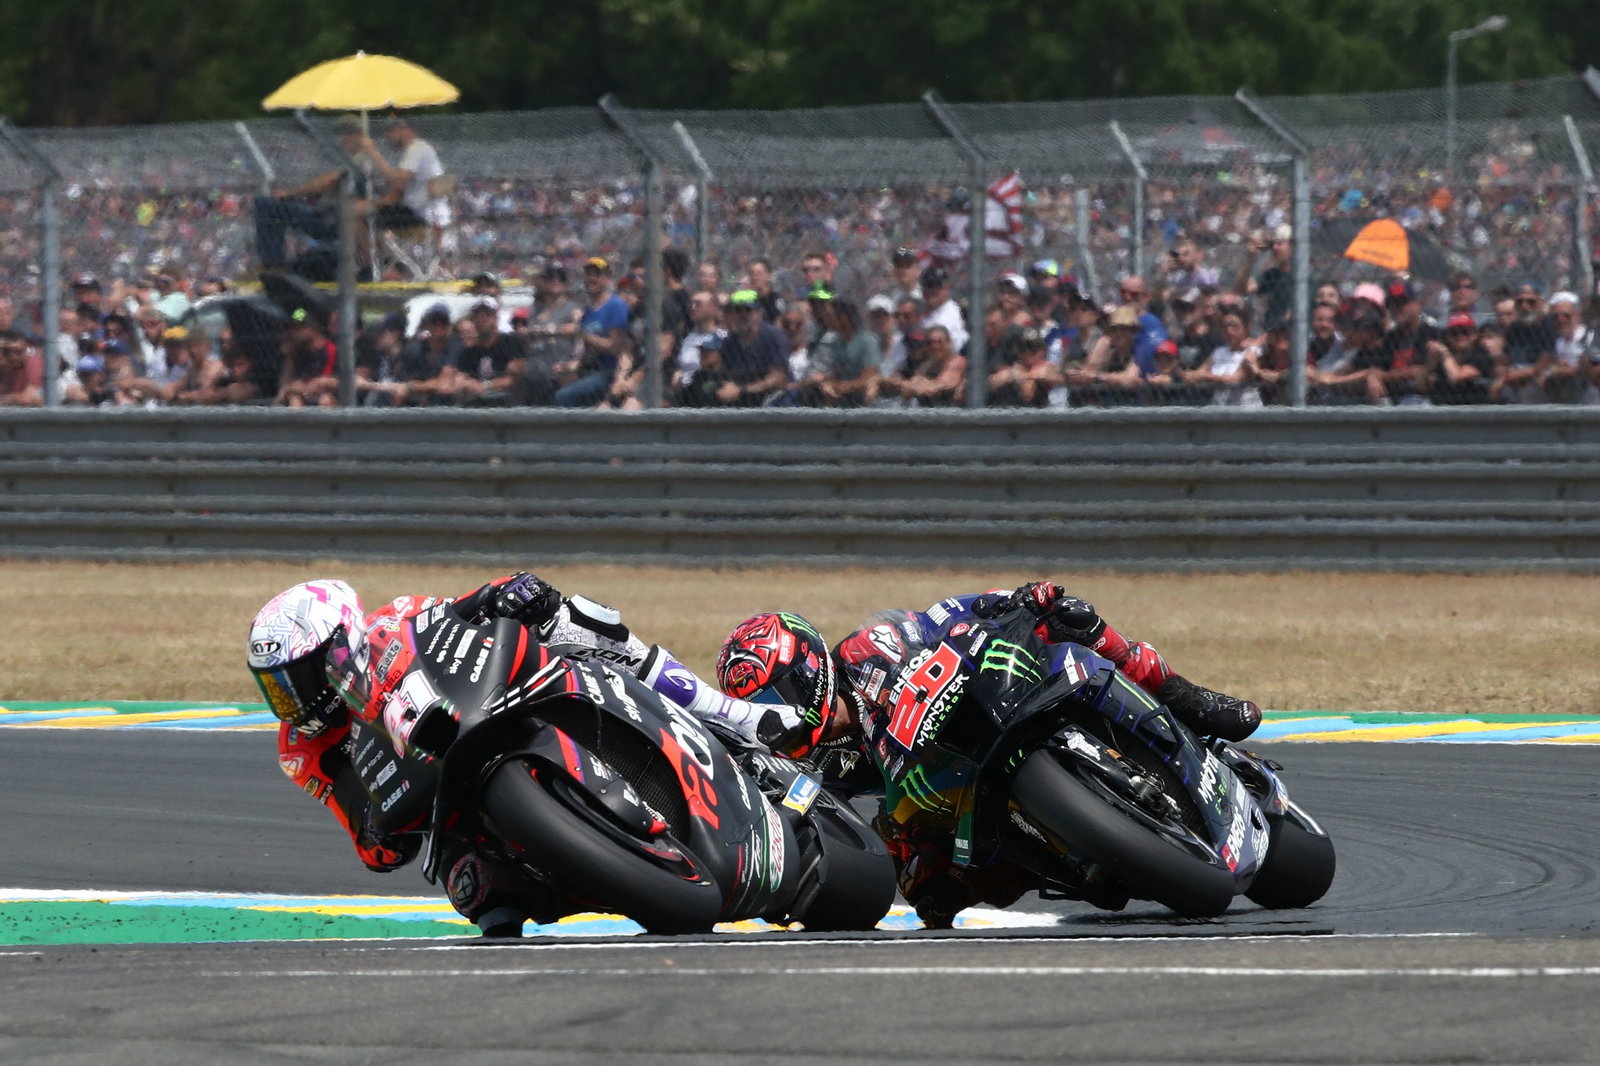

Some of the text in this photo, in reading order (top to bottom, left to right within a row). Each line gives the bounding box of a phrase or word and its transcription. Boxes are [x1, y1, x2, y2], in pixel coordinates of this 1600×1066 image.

[450, 658, 462, 674] sky
[470, 648, 489, 683] CASE
[889, 648, 933, 705] ENEOS
[886, 641, 962, 751] 20
[917, 674, 970, 746] MONSTER
[929, 688, 964, 740] ENERGY
[381, 786, 403, 812] CASE
